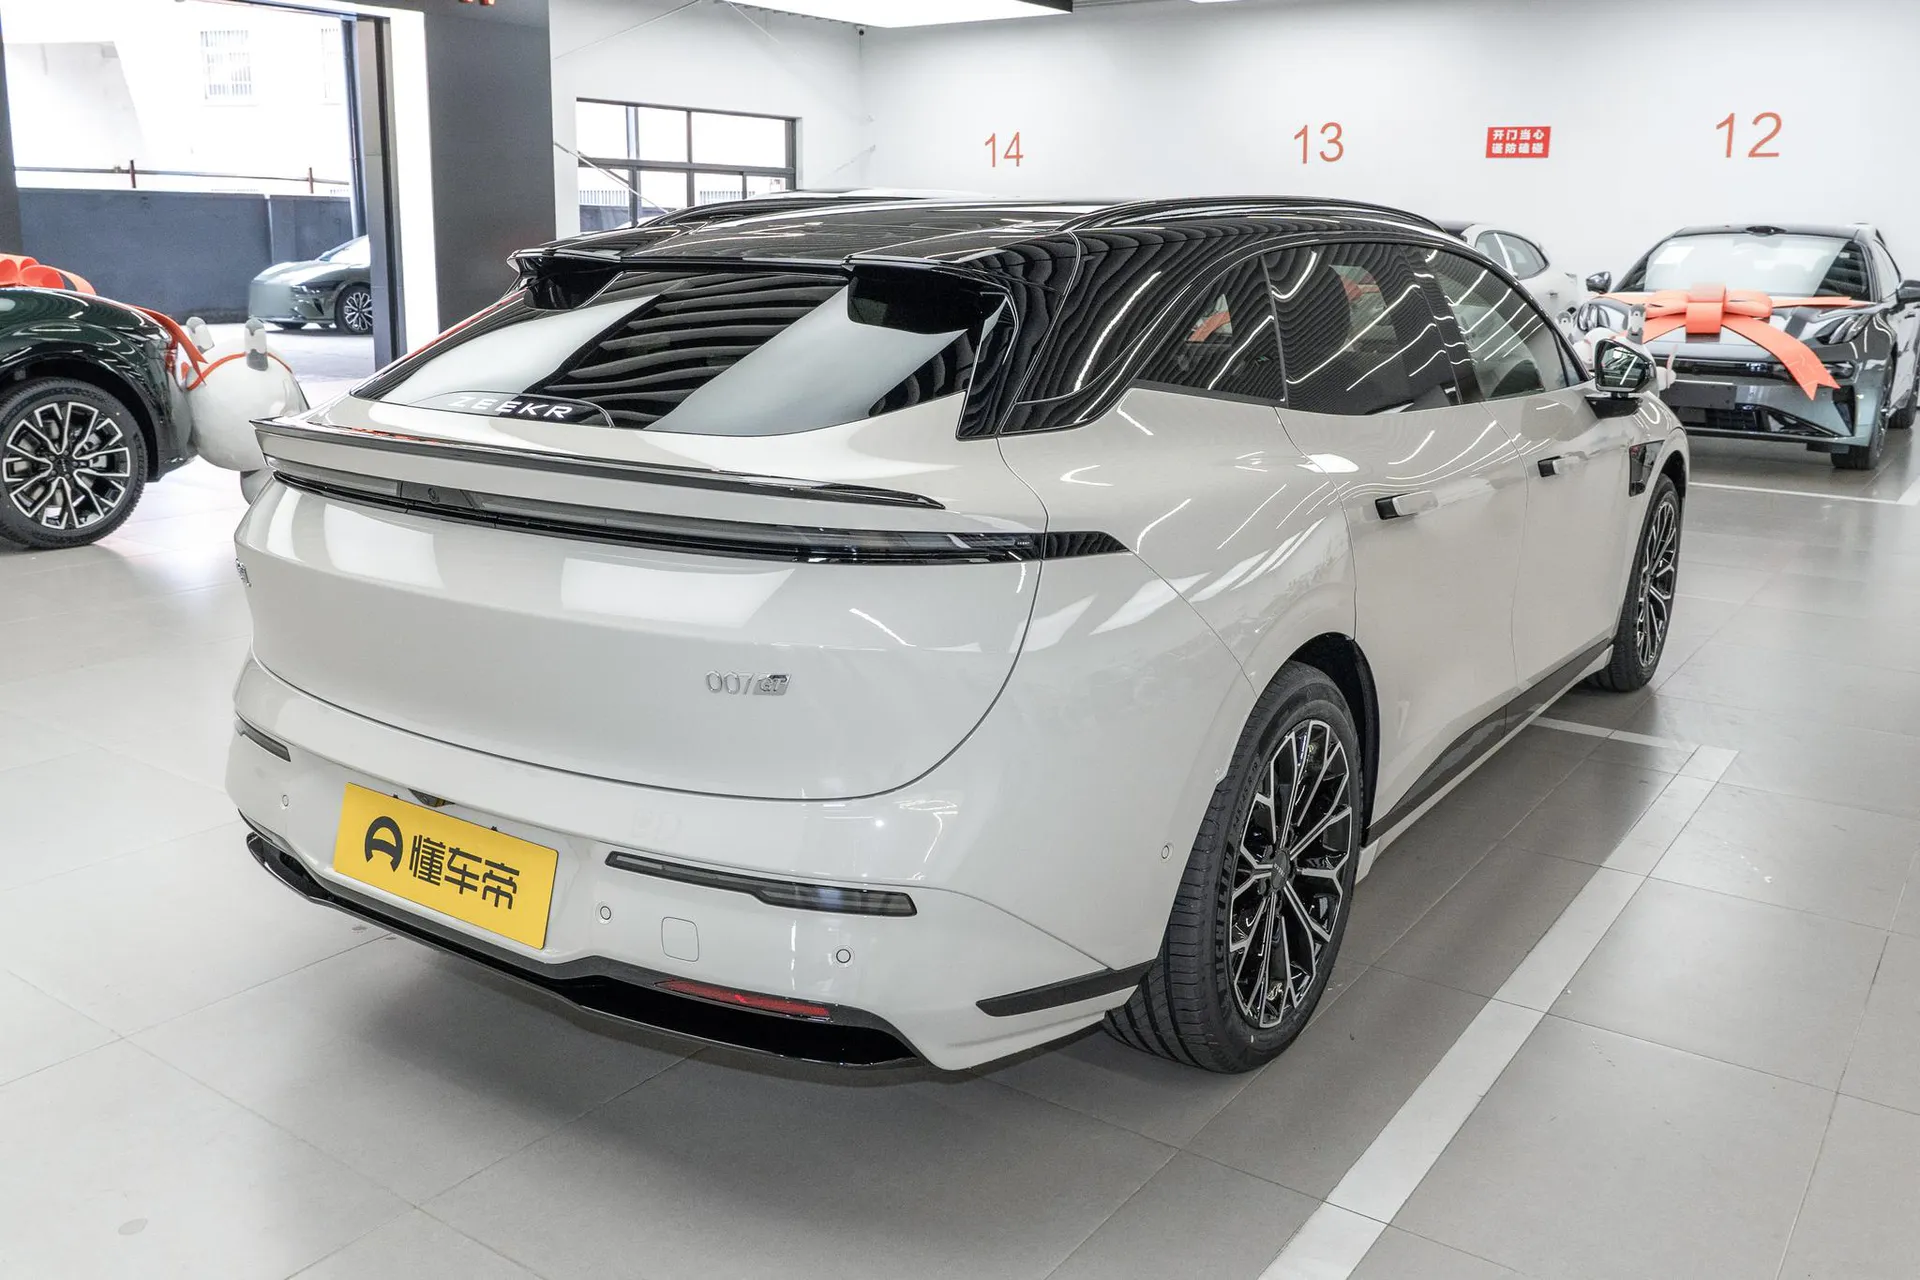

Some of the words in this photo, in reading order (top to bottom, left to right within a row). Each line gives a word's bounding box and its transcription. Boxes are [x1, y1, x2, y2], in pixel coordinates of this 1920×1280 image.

[985, 131, 1024, 167] 14
[1294, 122, 1344, 164] 13
[1492, 129, 1545, 141] 开门当心
[1716, 111, 1782, 159] 12
[448, 396, 573, 419] ZEEKR
[409, 835, 520, 910] 懂车帝
[1214, 851, 1234, 993] MICHELIN
